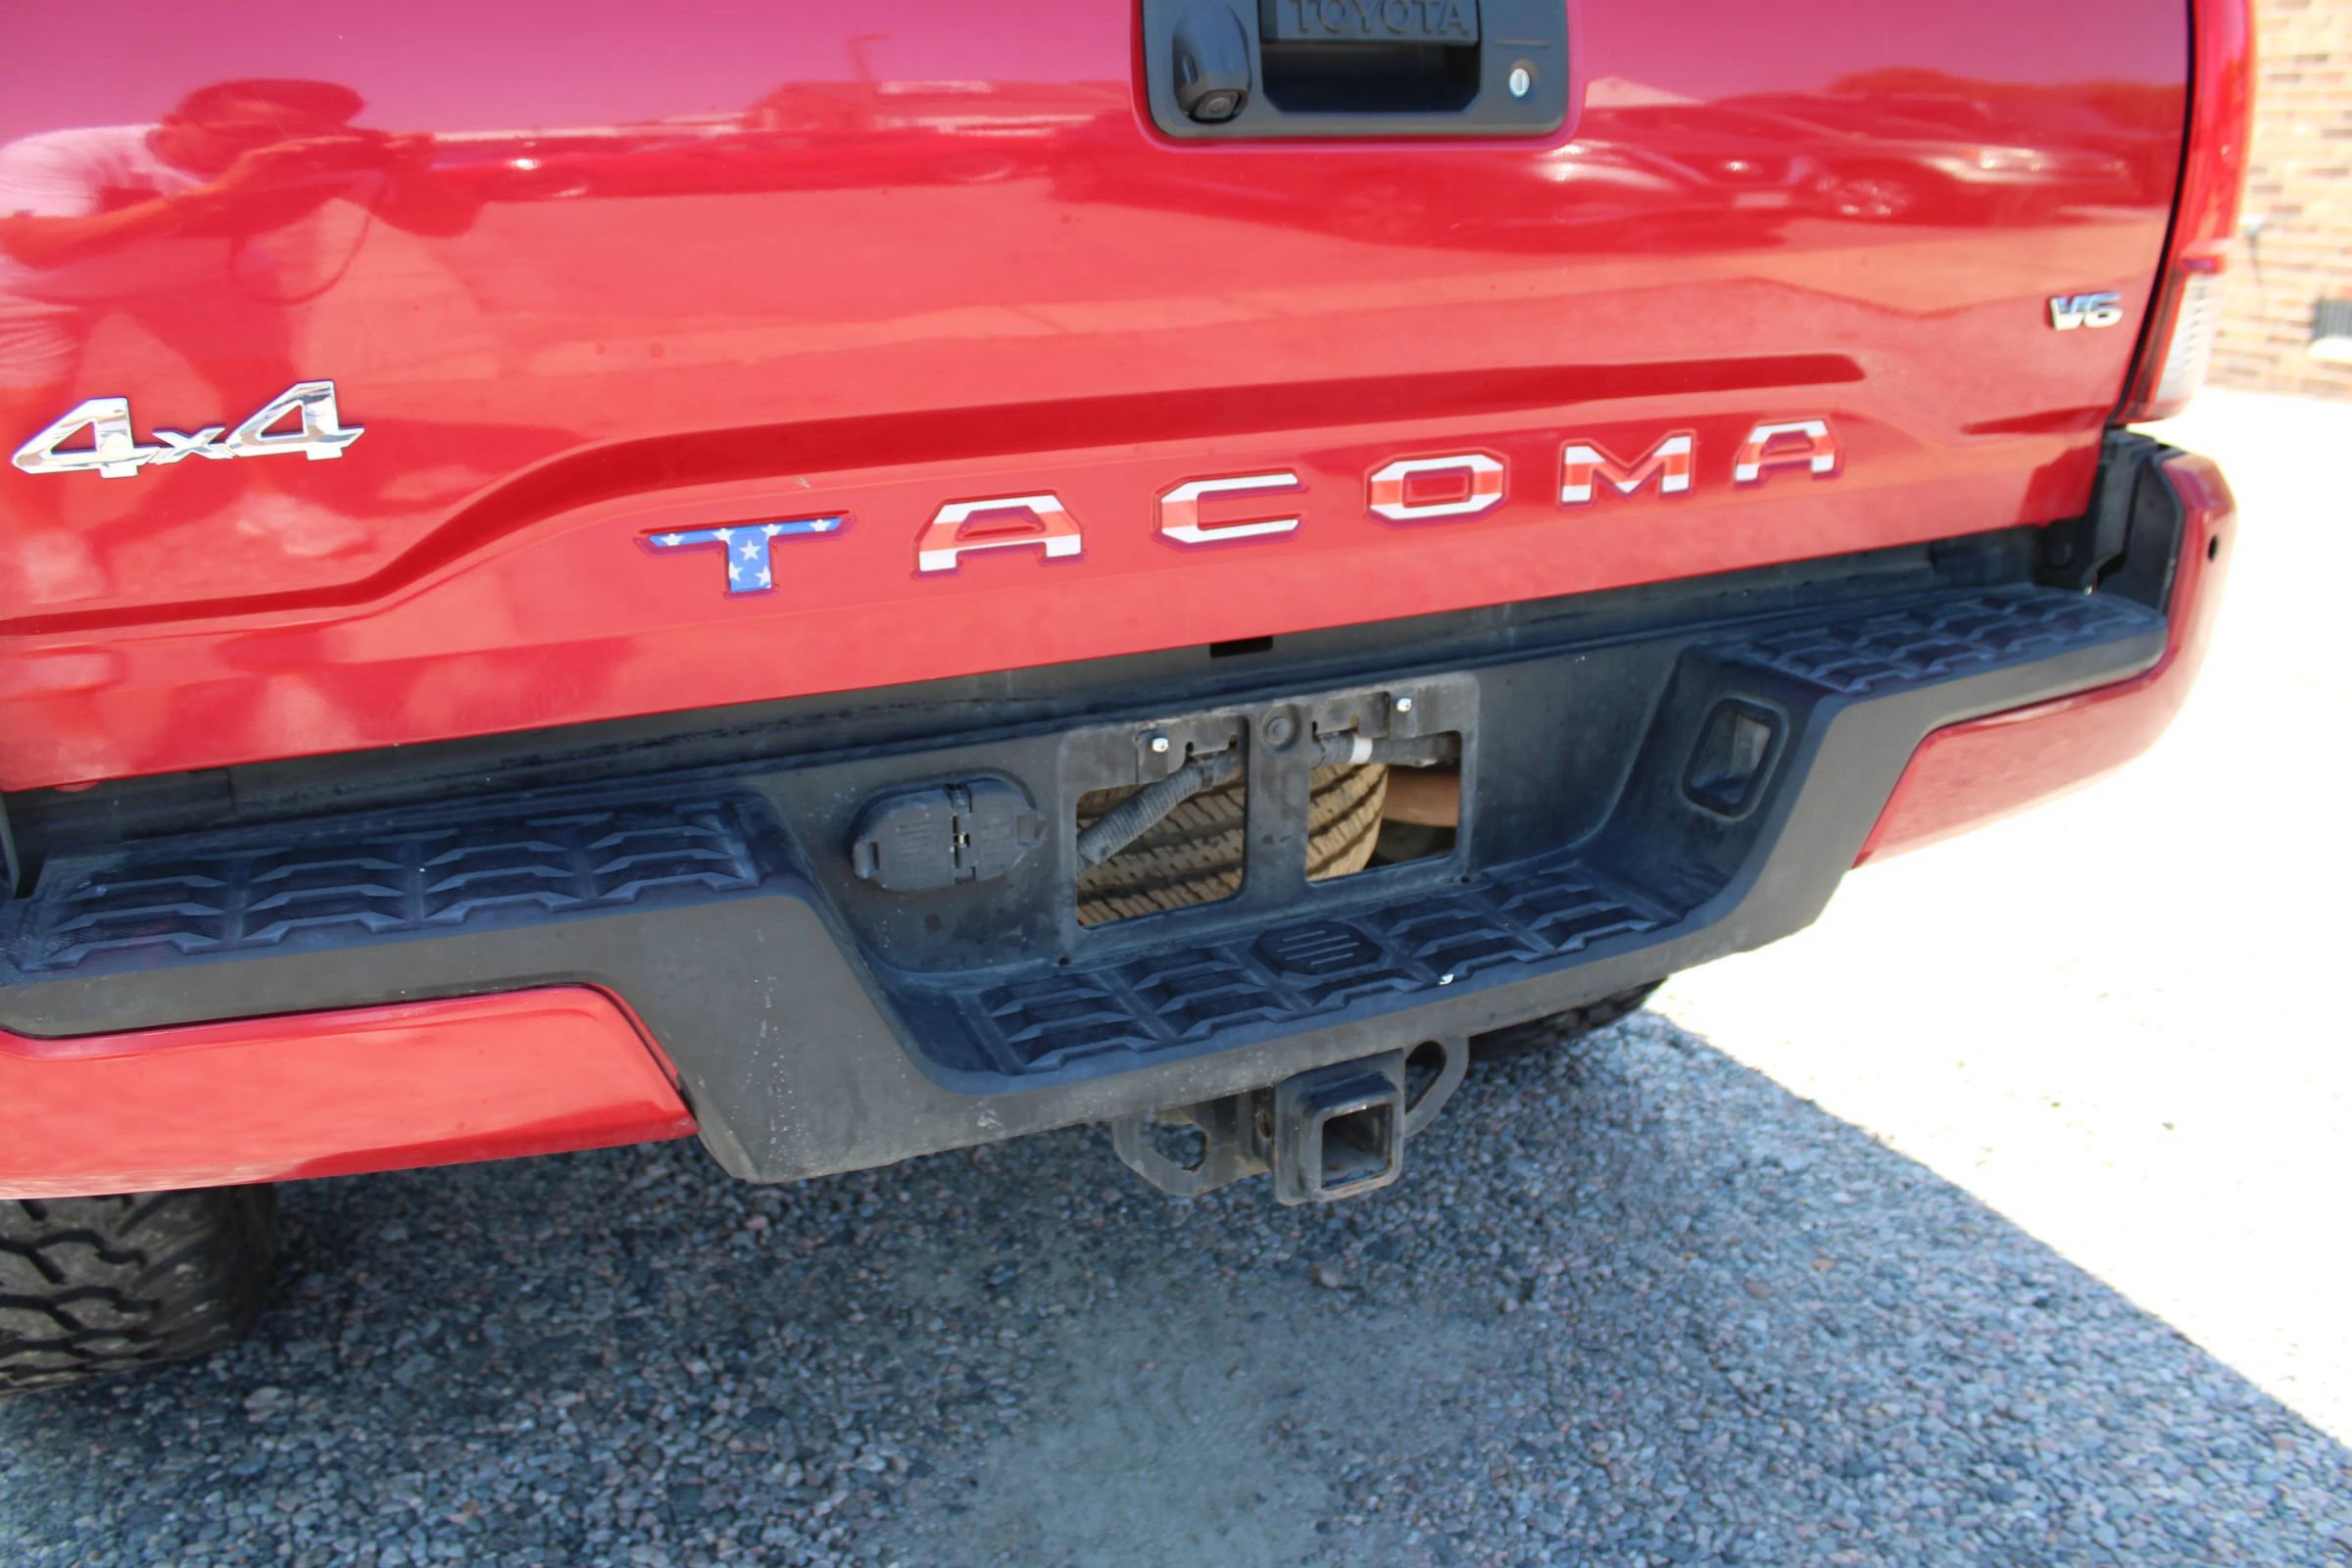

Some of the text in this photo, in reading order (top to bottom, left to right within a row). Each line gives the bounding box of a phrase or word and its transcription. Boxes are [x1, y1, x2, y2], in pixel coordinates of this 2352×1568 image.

[1288, 0, 1471, 35] TOYOTA
[2049, 292, 2125, 330] V6
[12, 379, 366, 478] 4x4
[641, 418, 1838, 596] TACOMA
